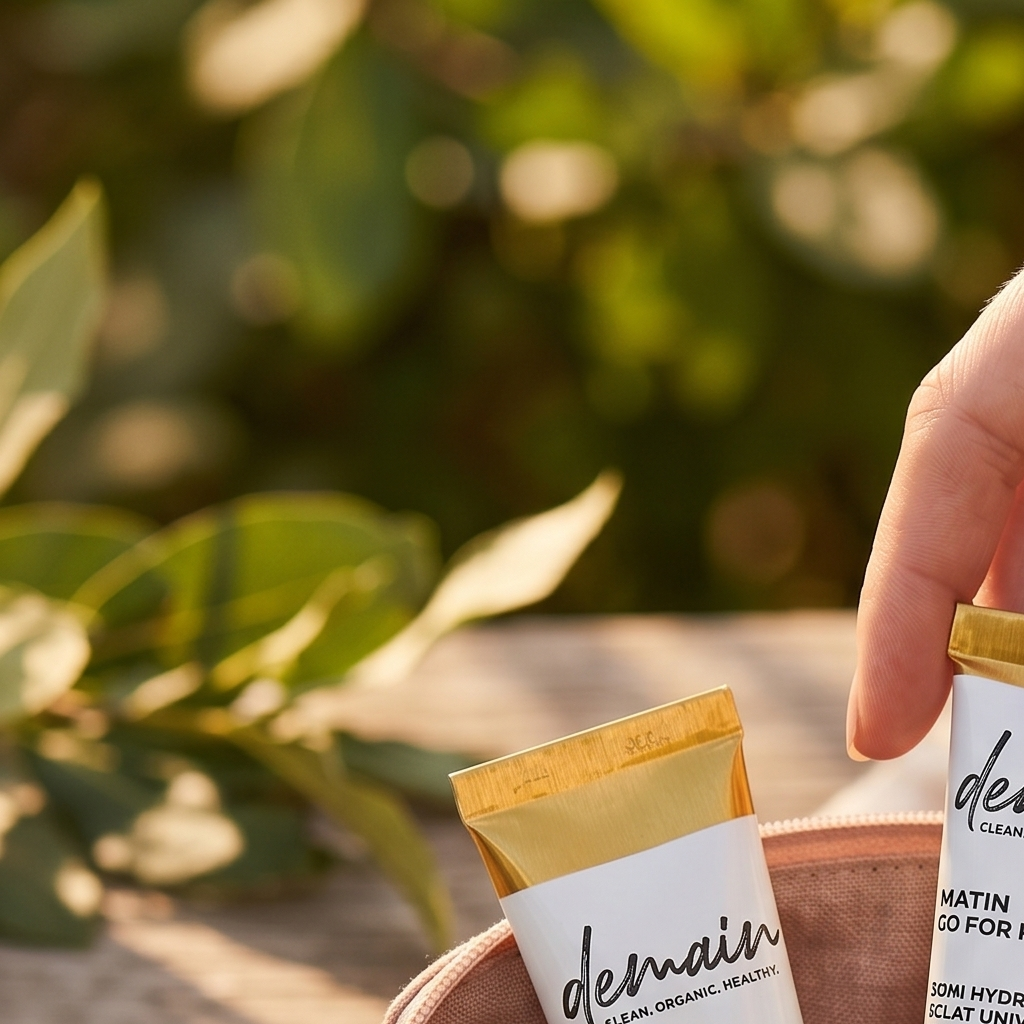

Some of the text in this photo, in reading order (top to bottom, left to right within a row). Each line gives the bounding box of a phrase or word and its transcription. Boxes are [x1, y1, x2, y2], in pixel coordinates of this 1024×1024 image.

[941, 889, 1009, 913] MATIN
[938, 914, 959, 932] GO
[965, 918, 1011, 938] FOR
[655, 985, 720, 1012] ORGANIC.
[723, 965, 779, 990] HEALTHY.
